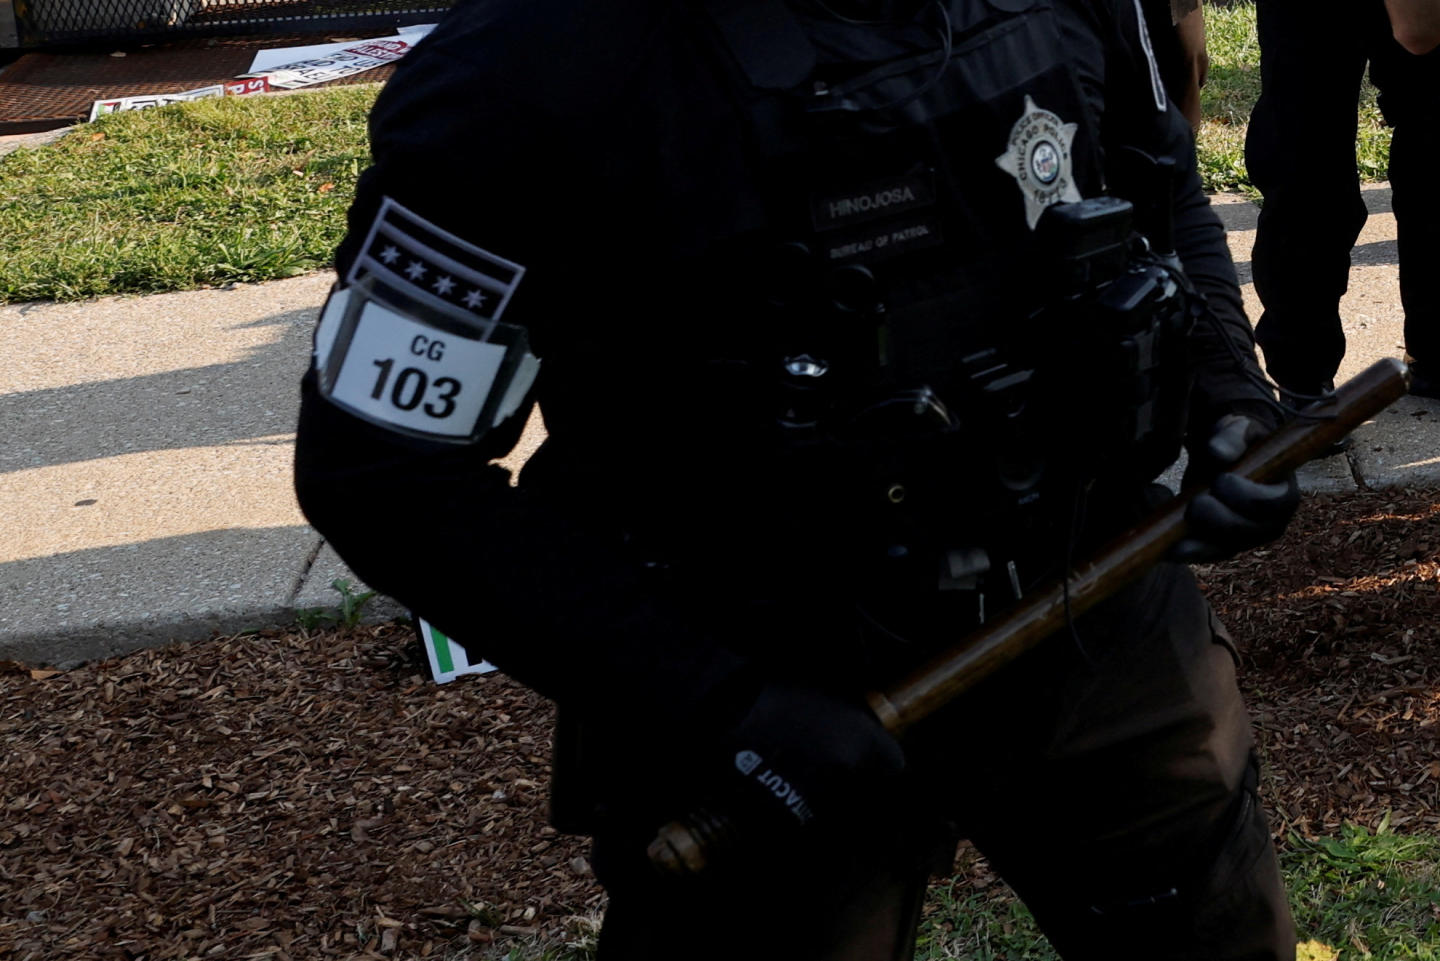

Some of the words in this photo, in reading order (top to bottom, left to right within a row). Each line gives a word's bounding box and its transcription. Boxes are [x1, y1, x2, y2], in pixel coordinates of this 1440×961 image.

[1017, 124, 1039, 181] CHICAGO
[830, 186, 915, 219] HINOJOSA
[410, 334, 445, 361] CG
[370, 357, 462, 419] 103
